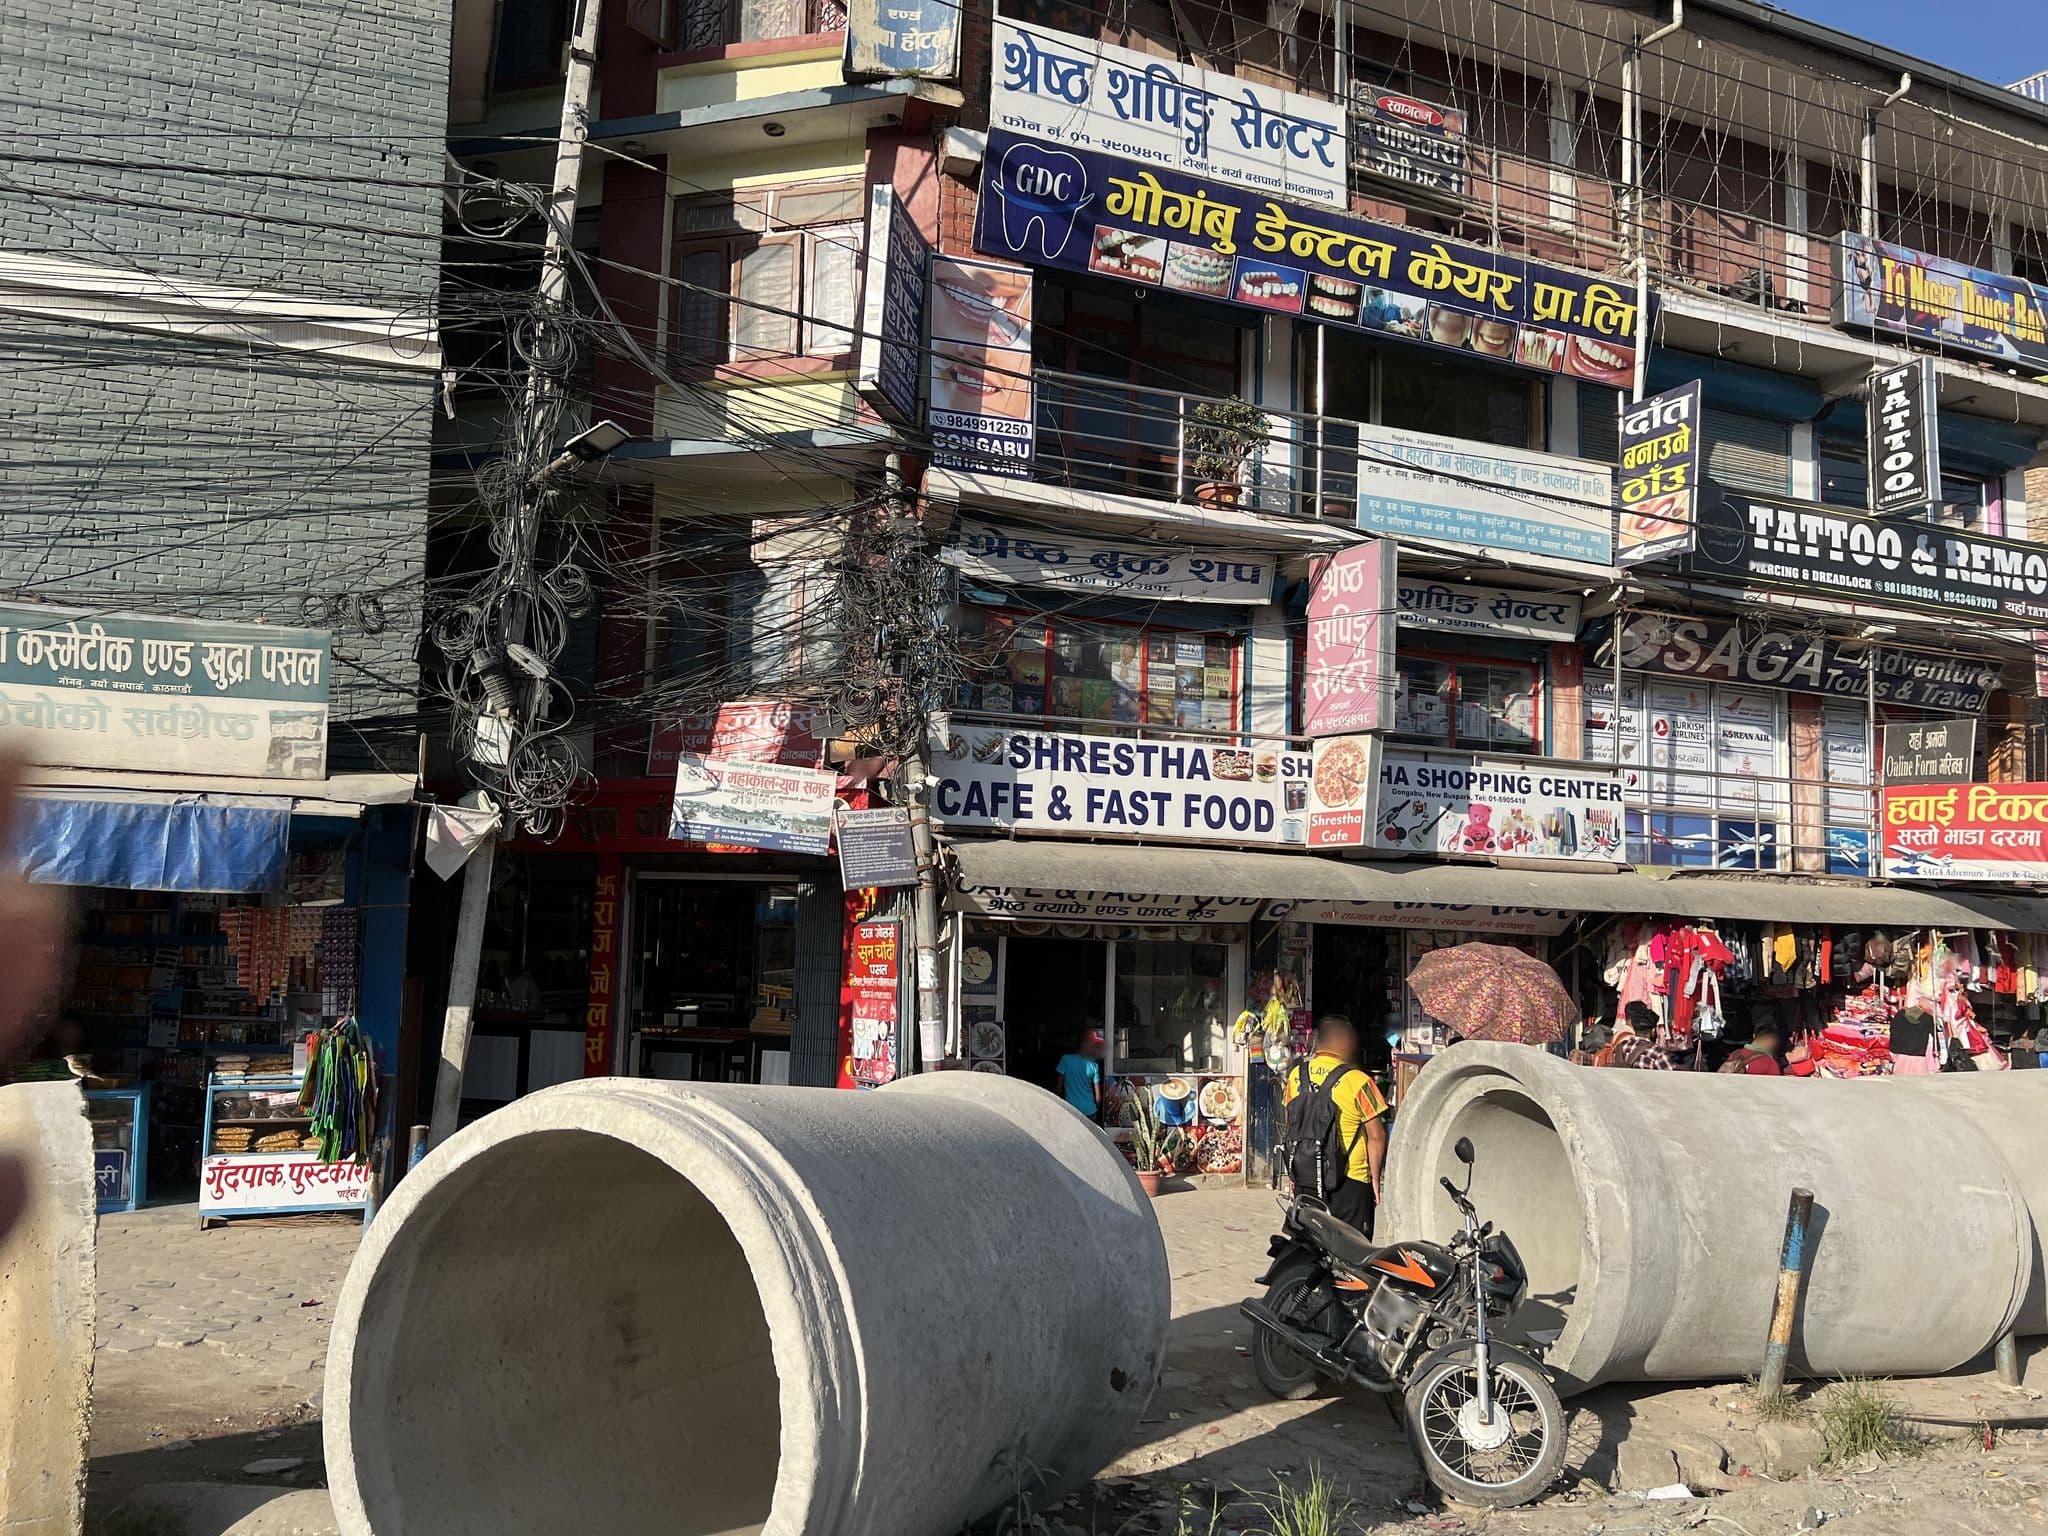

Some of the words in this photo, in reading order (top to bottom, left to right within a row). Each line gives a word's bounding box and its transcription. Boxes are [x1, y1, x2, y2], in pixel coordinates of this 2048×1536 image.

[1003, 29, 1094, 105] श्रेष्ठ
[1230, 88, 1338, 169] सेन्टर
[1002, 113, 1042, 132] फोन
[1015, 162, 1072, 202] GDC
[1106, 171, 1242, 257] गोगंबु
[1253, 202, 1398, 280] डेन्टल
[1408, 244, 1526, 317] केयर
[946, 414, 1029, 437] 9849912250
[1624, 391, 1695, 437] दाँत
[1880, 367, 1916, 493] TATTOO
[1622, 425, 1692, 470] बनाउने
[1621, 462, 1693, 504] ठाँउ
[1748, 504, 1903, 570] TATTOO
[1910, 533, 1938, 578] &
[1090, 548, 1176, 579] बुक
[1188, 557, 1264, 586] शप
[1811, 570, 1873, 591] DREADLOCK
[1488, 593, 1571, 624] सेन्टर
[141, 638, 196, 678] एण्ड
[201, 641, 254, 691] खुद्रा
[260, 645, 323, 687] पसल
[1662, 618, 1826, 688] SAGA
[1866, 646, 2000, 692] Adventur
[1311, 658, 1373, 701] सेन्टर
[1584, 682, 1617, 696] QATA
[1894, 679, 1914, 699] &
[1609, 711, 1632, 724] Npal
[1671, 720, 1705, 732] TURKISH
[1671, 730, 1705, 741] AIRLINES
[1722, 729, 1754, 741] KOREAN
[1754, 733, 1771, 743] AIR
[1007, 734, 1212, 782] SHRESTHA
[1886, 754, 1914, 778] Online
[1914, 753, 1938, 777] Form
[1391, 787, 1425, 799] Gongabu,
[1426, 791, 1442, 800] New
[1416, 766, 1533, 796] SHOPPING
[1538, 777, 1624, 803] CENTER
[936, 778, 1034, 820] CAFE
[1046, 784, 1073, 823] &
[1085, 788, 1173, 827] FAST
[1183, 793, 1275, 833] FOOD
[1887, 787, 1959, 827] हवाई
[1310, 811, 1362, 828] Shrestha
[1320, 829, 1349, 843] Cafe
[1897, 824, 1941, 847] सस्तो
[1943, 828, 1986, 846] भाडा
[1990, 829, 2043, 848] दरमा
[1945, 867, 1985, 879] Adventure
[1987, 868, 2010, 879] Tours
[986, 896, 1029, 912] श्रेष्ठ
[1094, 904, 1131, 917] एण्ड
[857, 944, 874, 966] सुन
[868, 963, 888, 976] पसल
